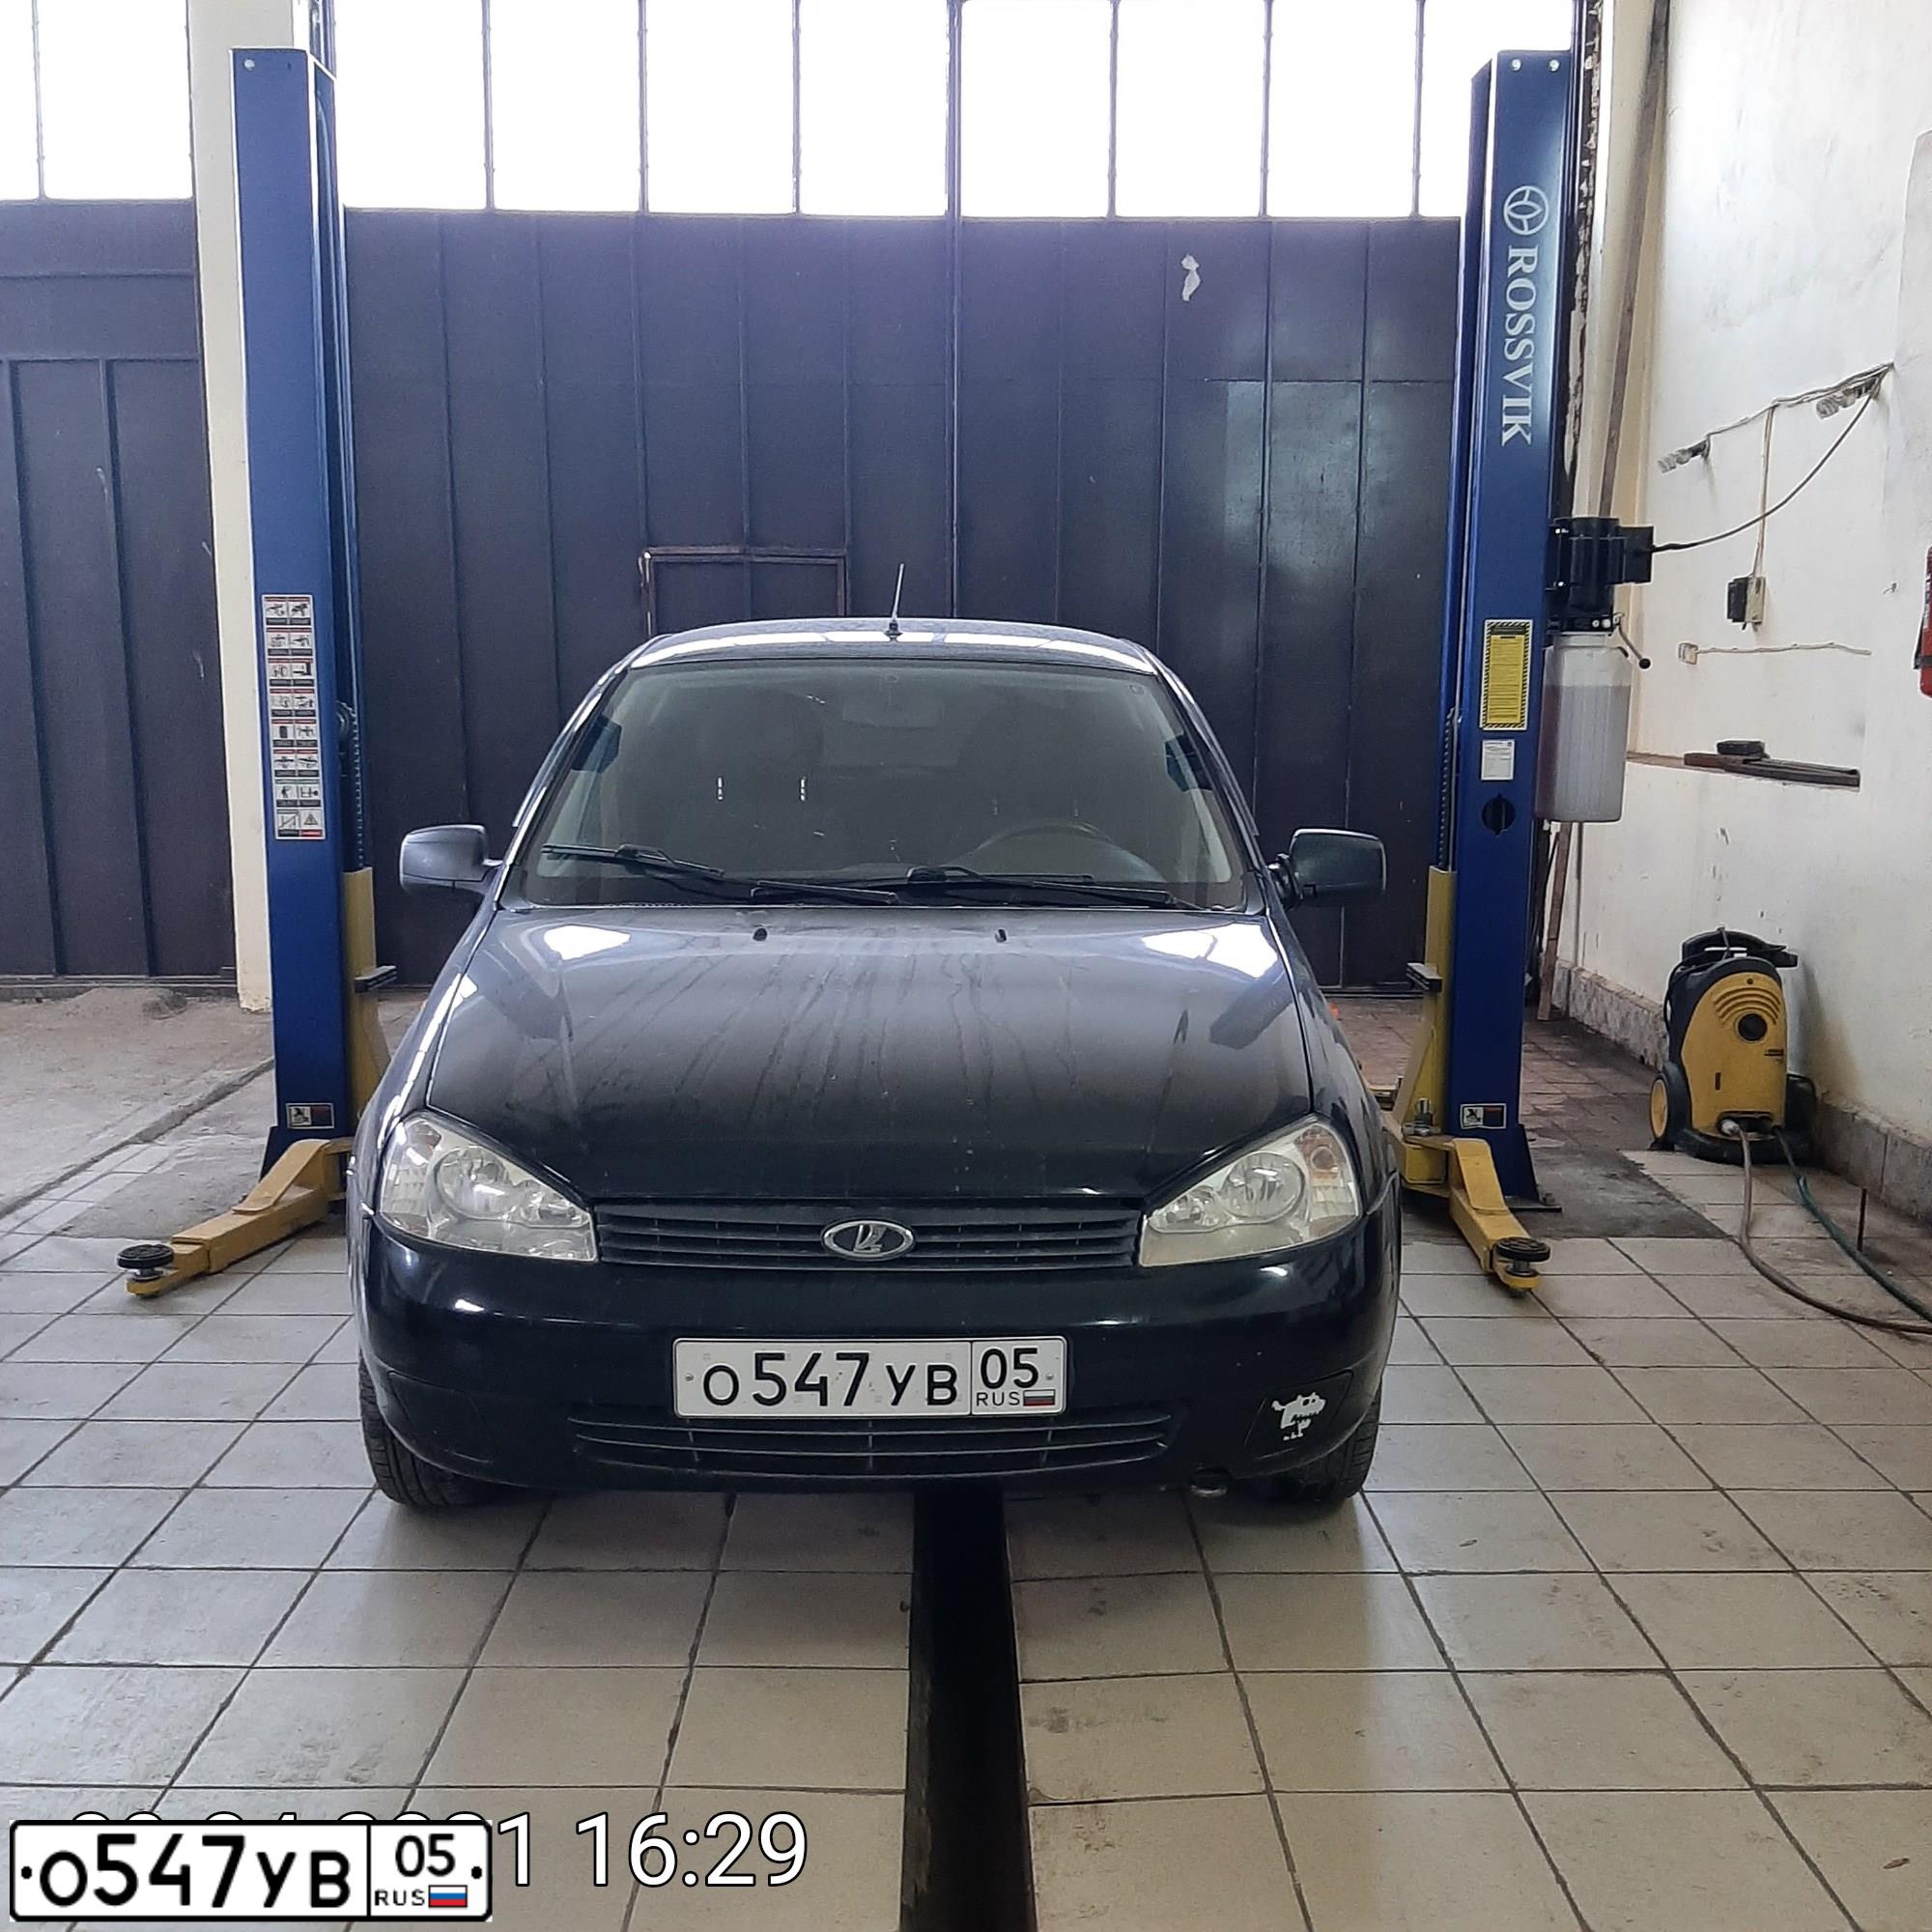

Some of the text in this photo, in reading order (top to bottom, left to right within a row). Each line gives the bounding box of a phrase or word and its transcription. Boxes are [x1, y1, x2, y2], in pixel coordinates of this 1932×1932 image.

[1501, 244, 1539, 446] ROSSVIK
[980, 1348, 1039, 1389] 05
[976, 1391, 1021, 1406] RUS
